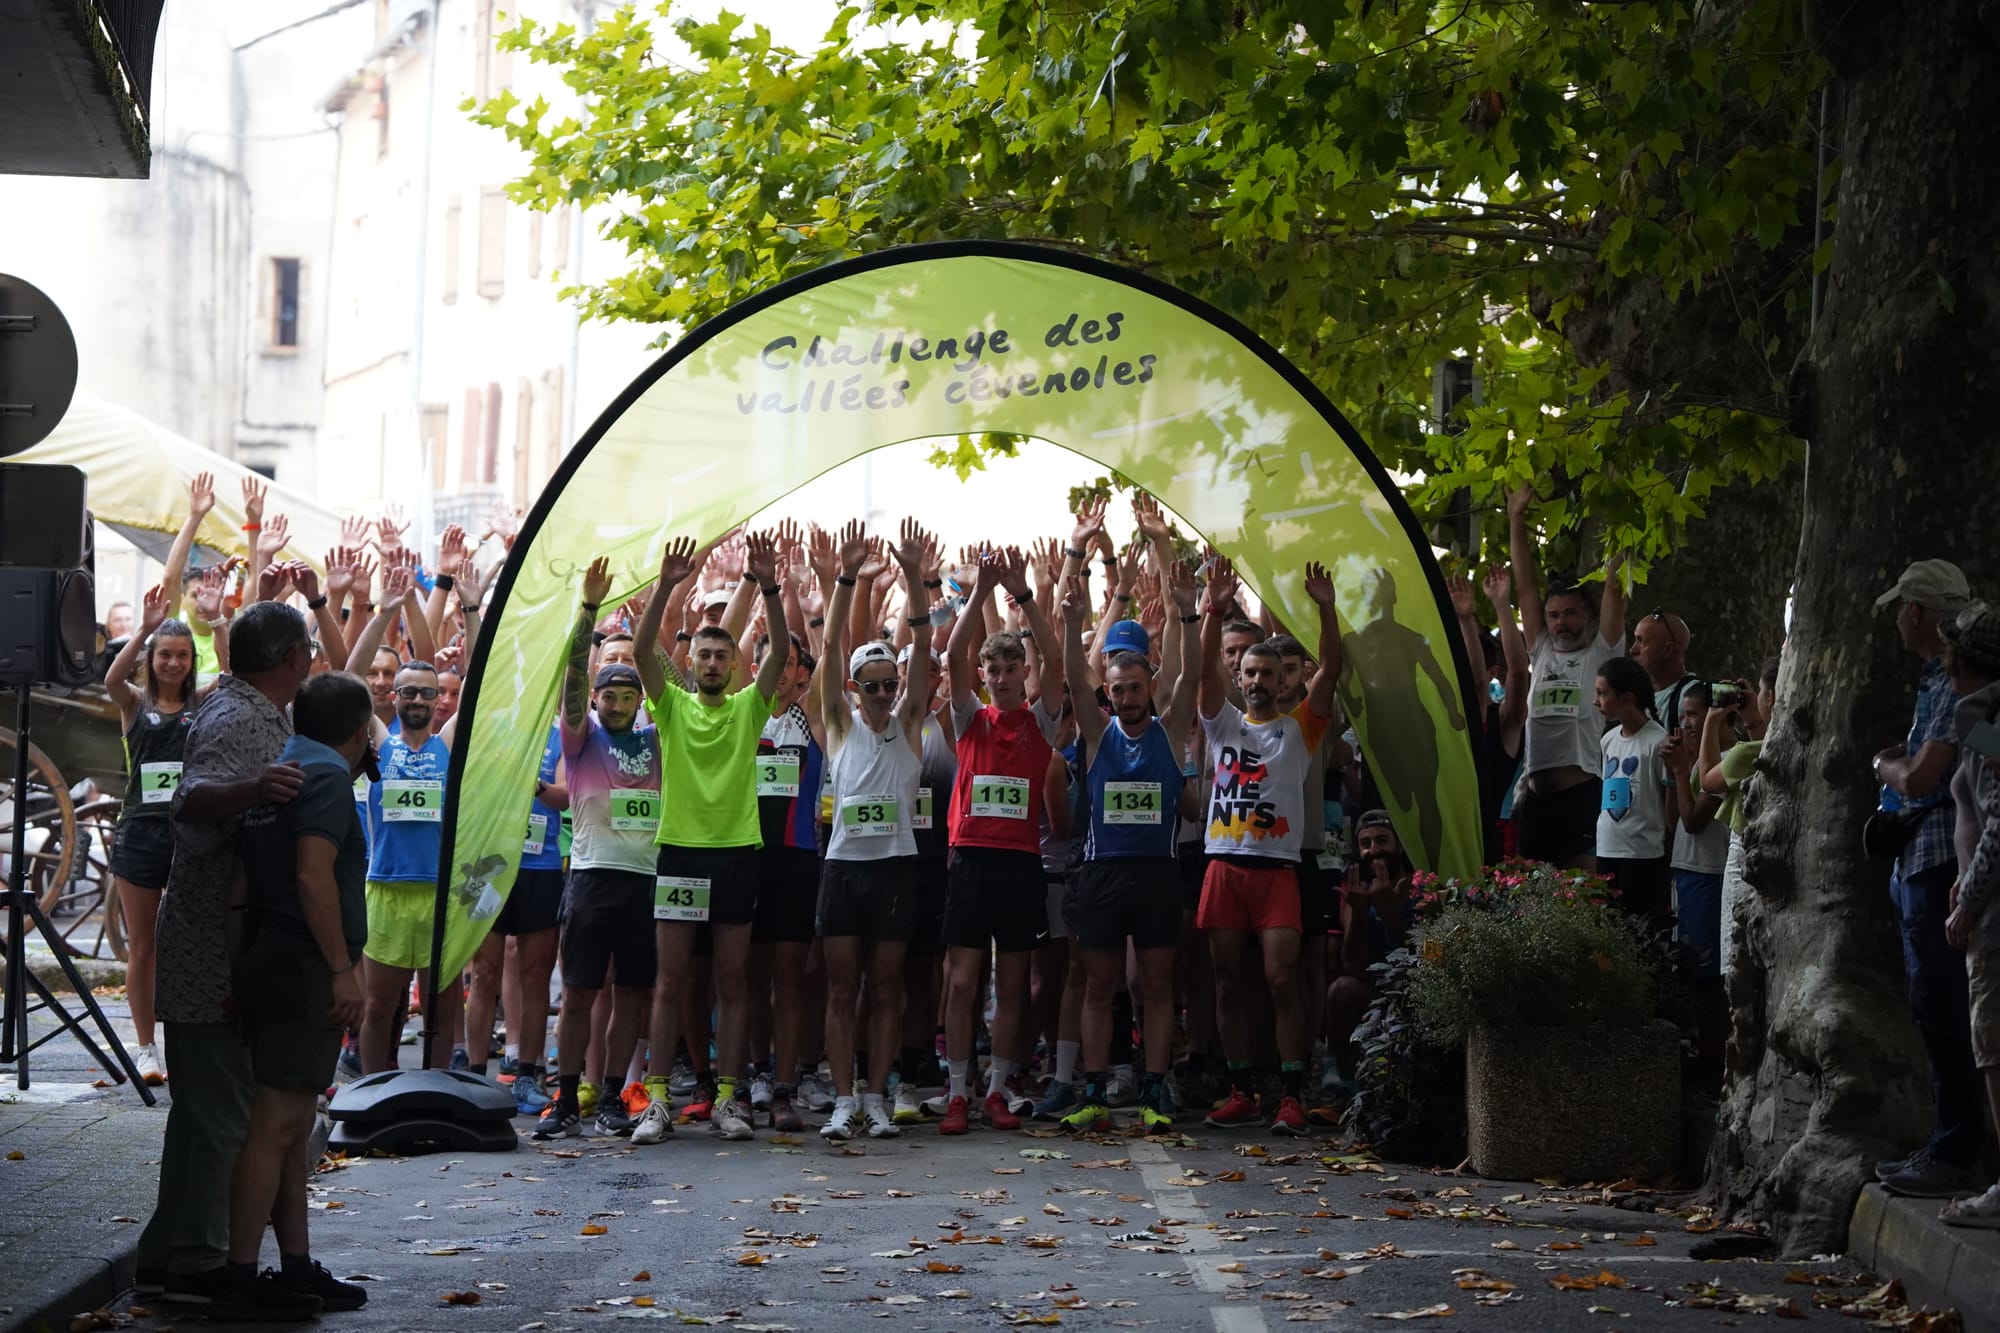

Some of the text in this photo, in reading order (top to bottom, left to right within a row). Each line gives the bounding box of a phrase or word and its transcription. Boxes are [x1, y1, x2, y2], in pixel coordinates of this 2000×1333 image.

[761, 312, 1124, 372] Challenge des
[737, 354, 1157, 415] vallées cévenoles
[1539, 689, 1573, 705] 117
[1220, 746, 1261, 773] DE
[980, 786, 1021, 804] 113
[1215, 774, 1260, 799] ME
[397, 790, 426, 807] 46
[1112, 792, 1154, 810] 134
[626, 800, 650, 816] 60
[857, 804, 884, 822] 53
[1212, 801, 1276, 829] NTS
[667, 888, 694, 906] 43
